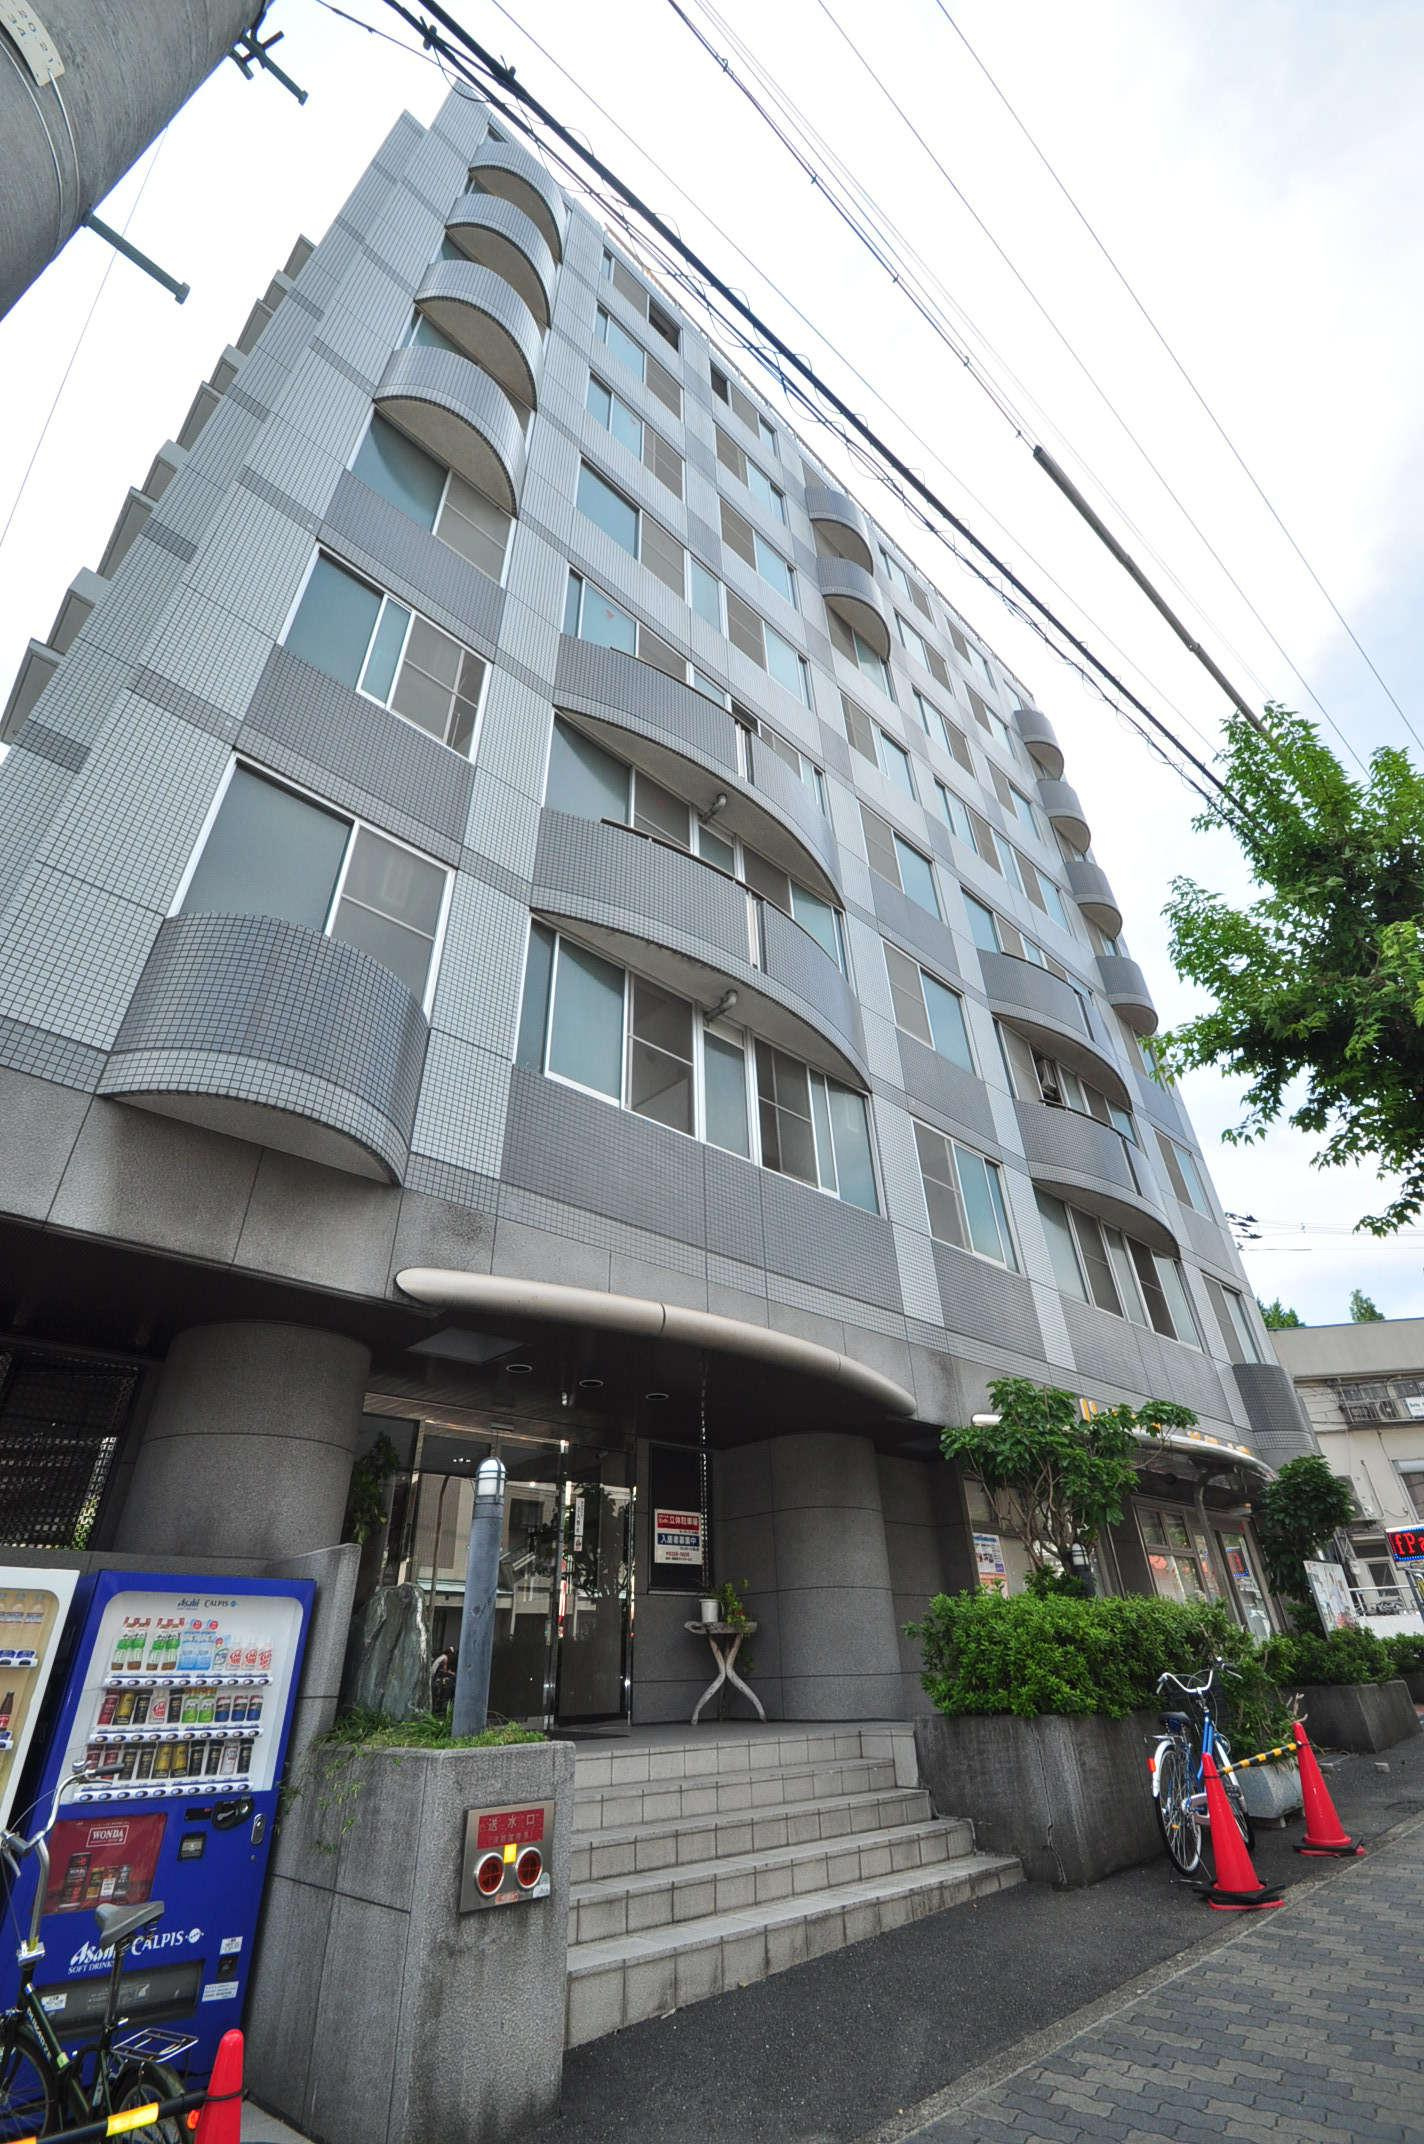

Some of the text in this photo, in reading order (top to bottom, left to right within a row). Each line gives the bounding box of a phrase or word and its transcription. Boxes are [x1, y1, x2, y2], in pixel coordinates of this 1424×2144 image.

[204, 1599, 229, 1608] CALPIS
[92, 1829, 125, 1840] WONDA
[131, 1929, 185, 1956] CALPIS
[68, 1965, 88, 1976] SOFT
